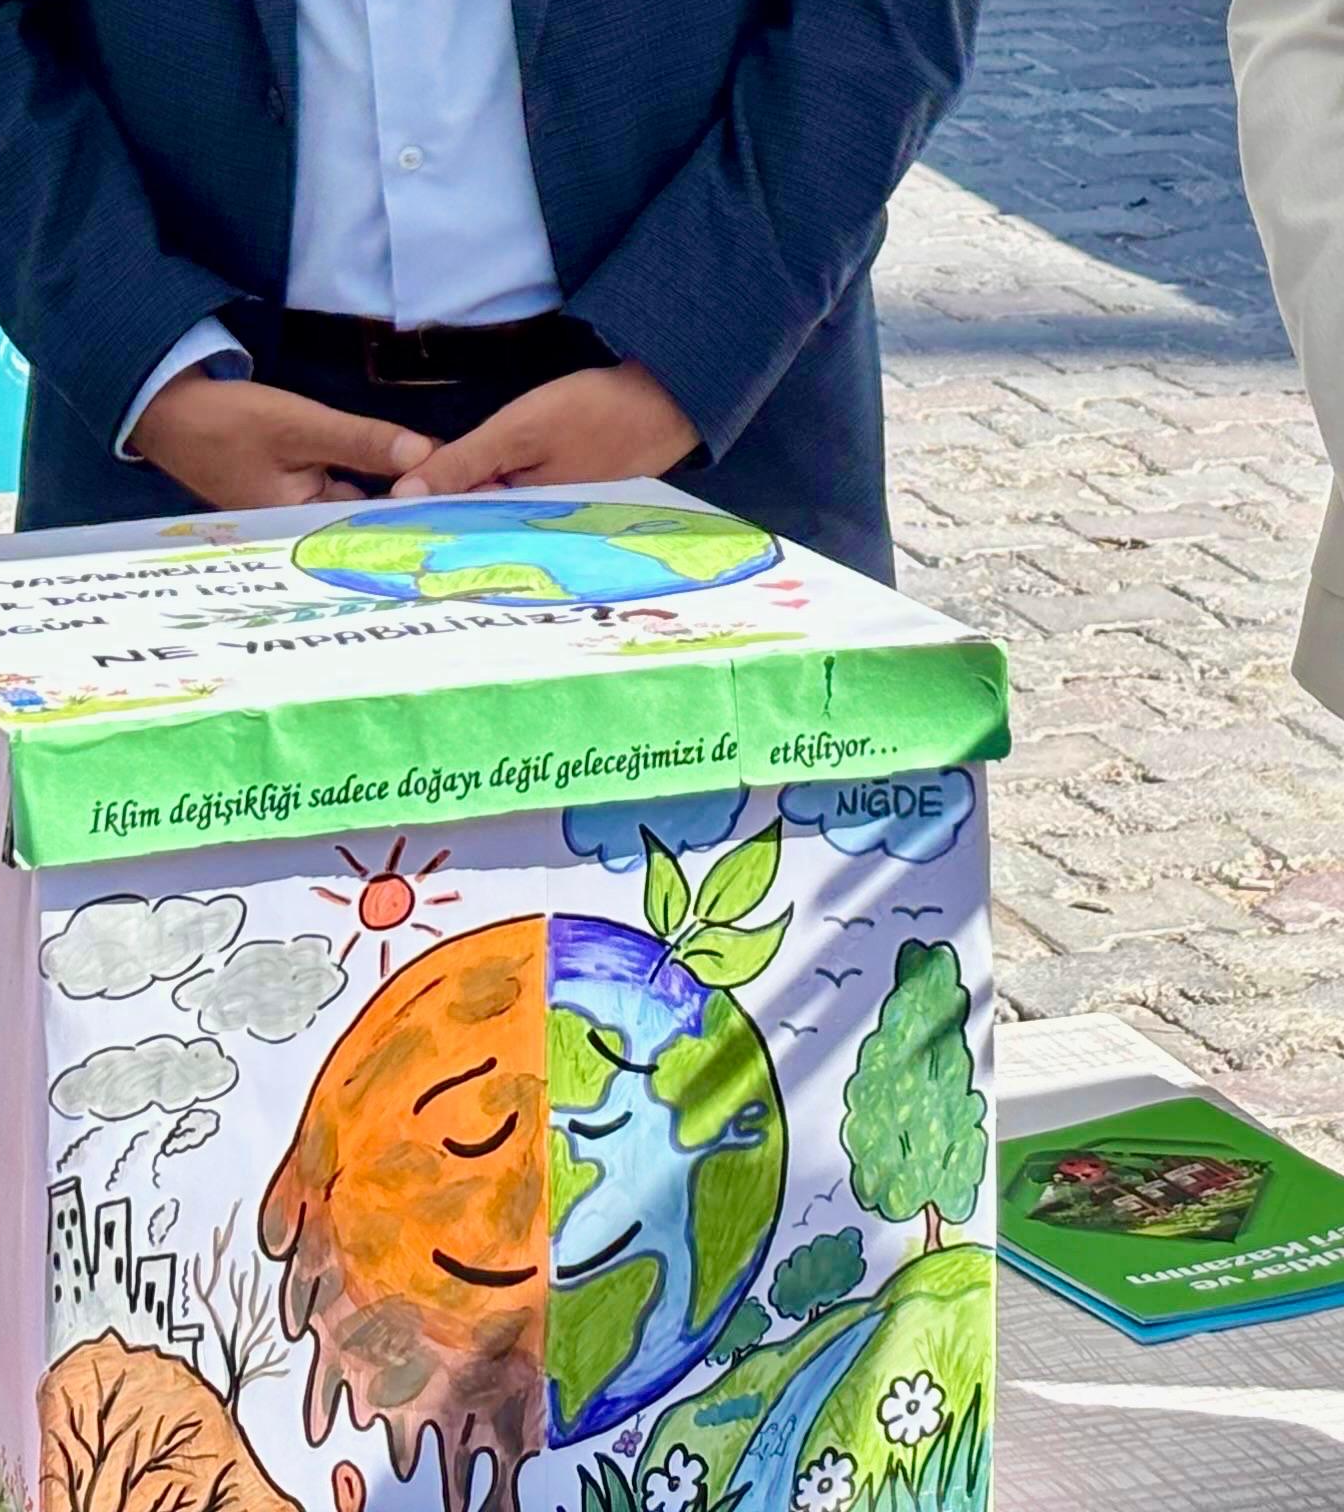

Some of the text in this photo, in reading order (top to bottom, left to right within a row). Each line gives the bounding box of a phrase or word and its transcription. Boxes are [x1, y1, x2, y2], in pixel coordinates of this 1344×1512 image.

[92, 645, 199, 669] NE
[89, 800, 160, 838] İklim
[169, 782, 302, 826] değişikliği
[307, 774, 390, 808] sadece
[397, 767, 482, 803] doğayı
[488, 751, 554, 793] değil
[555, 744, 706, 788] geleceğimizi
[710, 732, 738, 764] de
[1189, 1273, 1244, 1293] ve
